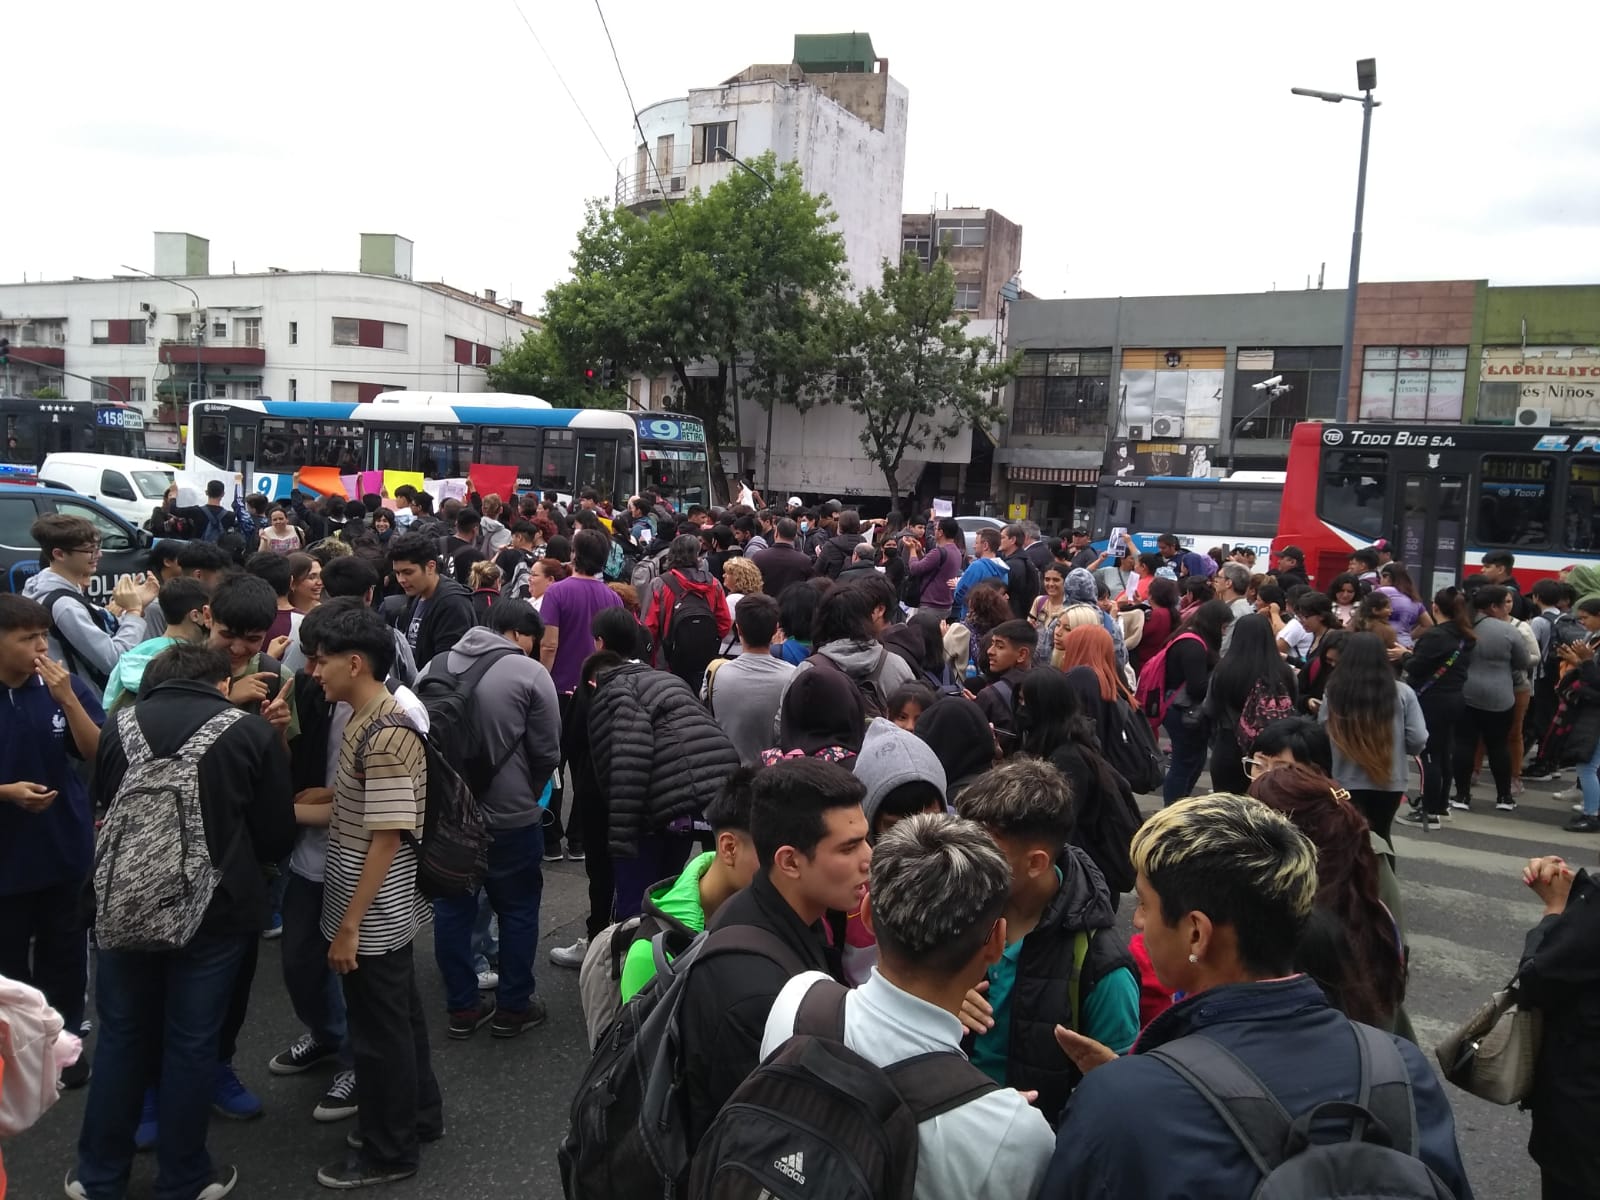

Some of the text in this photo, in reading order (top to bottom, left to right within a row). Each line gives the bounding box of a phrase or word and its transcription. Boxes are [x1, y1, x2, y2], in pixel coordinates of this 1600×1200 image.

[1520, 385, 1540, 398] és
[1548, 385, 1595, 398] Niños
[103, 411, 123, 426] 158
[650, 420, 679, 440] 9
[681, 432, 704, 442] RETIRO
[1533, 435, 1570, 451] EL
[258, 476, 272, 497] 9
[774, 1160, 806, 1185] adidas
